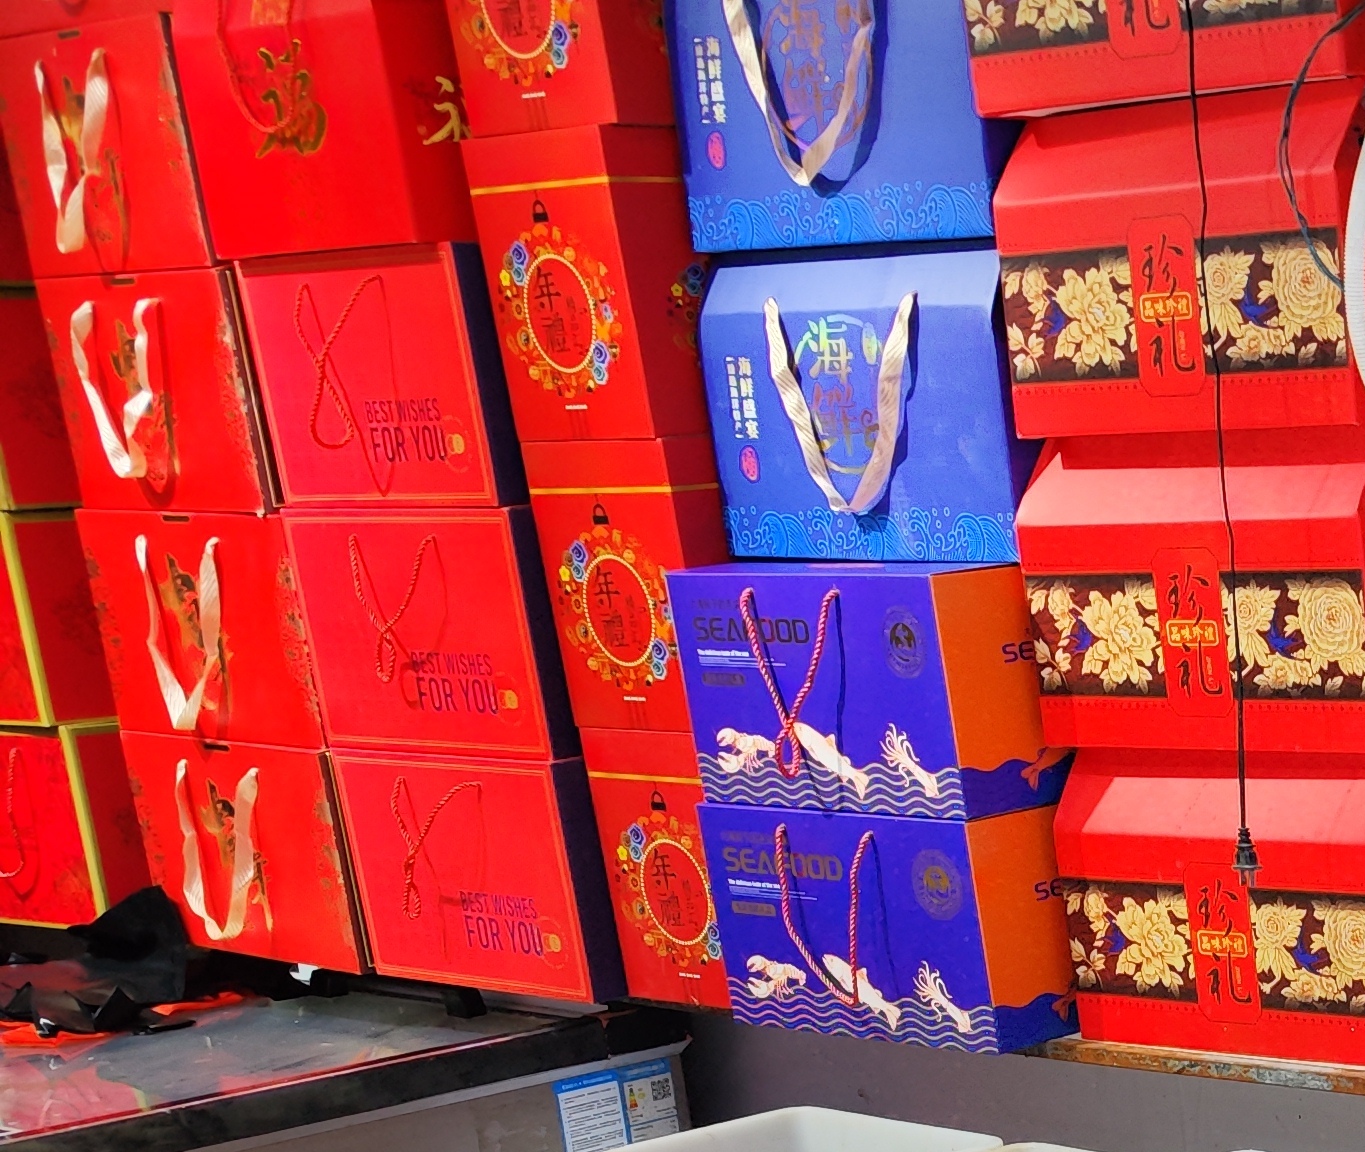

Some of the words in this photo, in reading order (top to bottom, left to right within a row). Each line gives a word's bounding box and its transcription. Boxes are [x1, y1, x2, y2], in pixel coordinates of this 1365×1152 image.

[365, 400, 395, 423] BEST
[395, 398, 441, 422] WISHES
[370, 426, 409, 462] FOR
[409, 425, 447, 461] YOU
[410, 651, 441, 674] BEST
[442, 652, 493, 677] WISHES
[416, 676, 459, 712] FOR
[458, 677, 499, 715] YOU
[459, 890, 488, 913] BEST
[490, 894, 538, 919] WISHES
[464, 915, 503, 951] FOR
[504, 919, 543, 956] YOU
